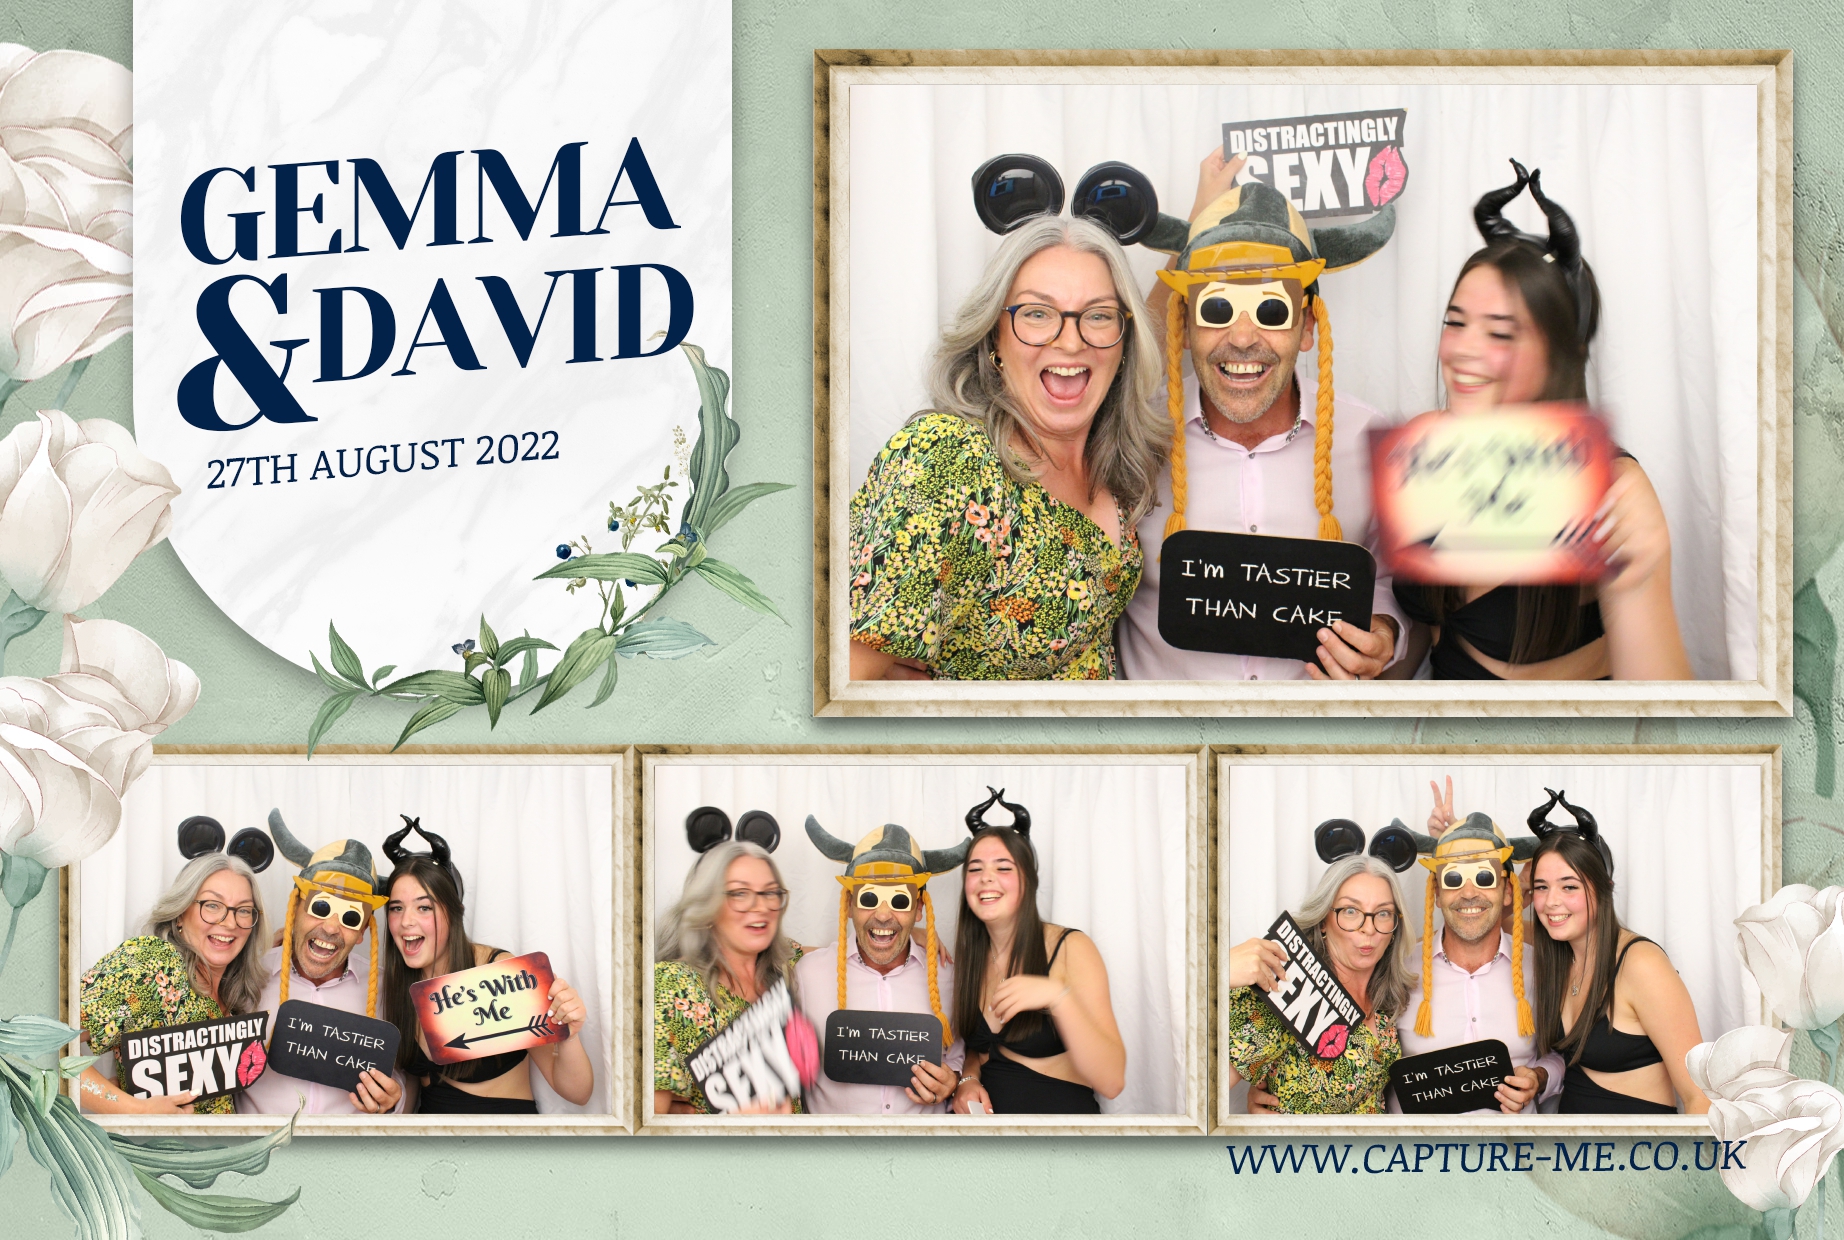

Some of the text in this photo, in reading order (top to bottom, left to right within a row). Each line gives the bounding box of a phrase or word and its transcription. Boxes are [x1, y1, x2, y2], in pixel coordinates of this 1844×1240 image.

[1229, 116, 1399, 154] DISTRACTINGLY
[1181, 559, 1225, 579] I'm
[1185, 598, 1343, 627] THAN CAKE
[1276, 919, 1361, 1027] DISTRACTINGLY
[428, 969, 539, 1015] He's With
[287, 1017, 313, 1033] I'm
[472, 999, 513, 1026] Me
[127, 1018, 264, 1060] DISTRACTINGLY
[836, 1026, 860, 1038] I'm
[286, 1041, 377, 1072] THAN CAKE
[838, 1049, 925, 1065] THAN CAKE
[131, 1042, 243, 1100] SEXY
[1402, 1071, 1428, 1084] I'm
[1412, 1076, 1500, 1103] THAN CAKE
